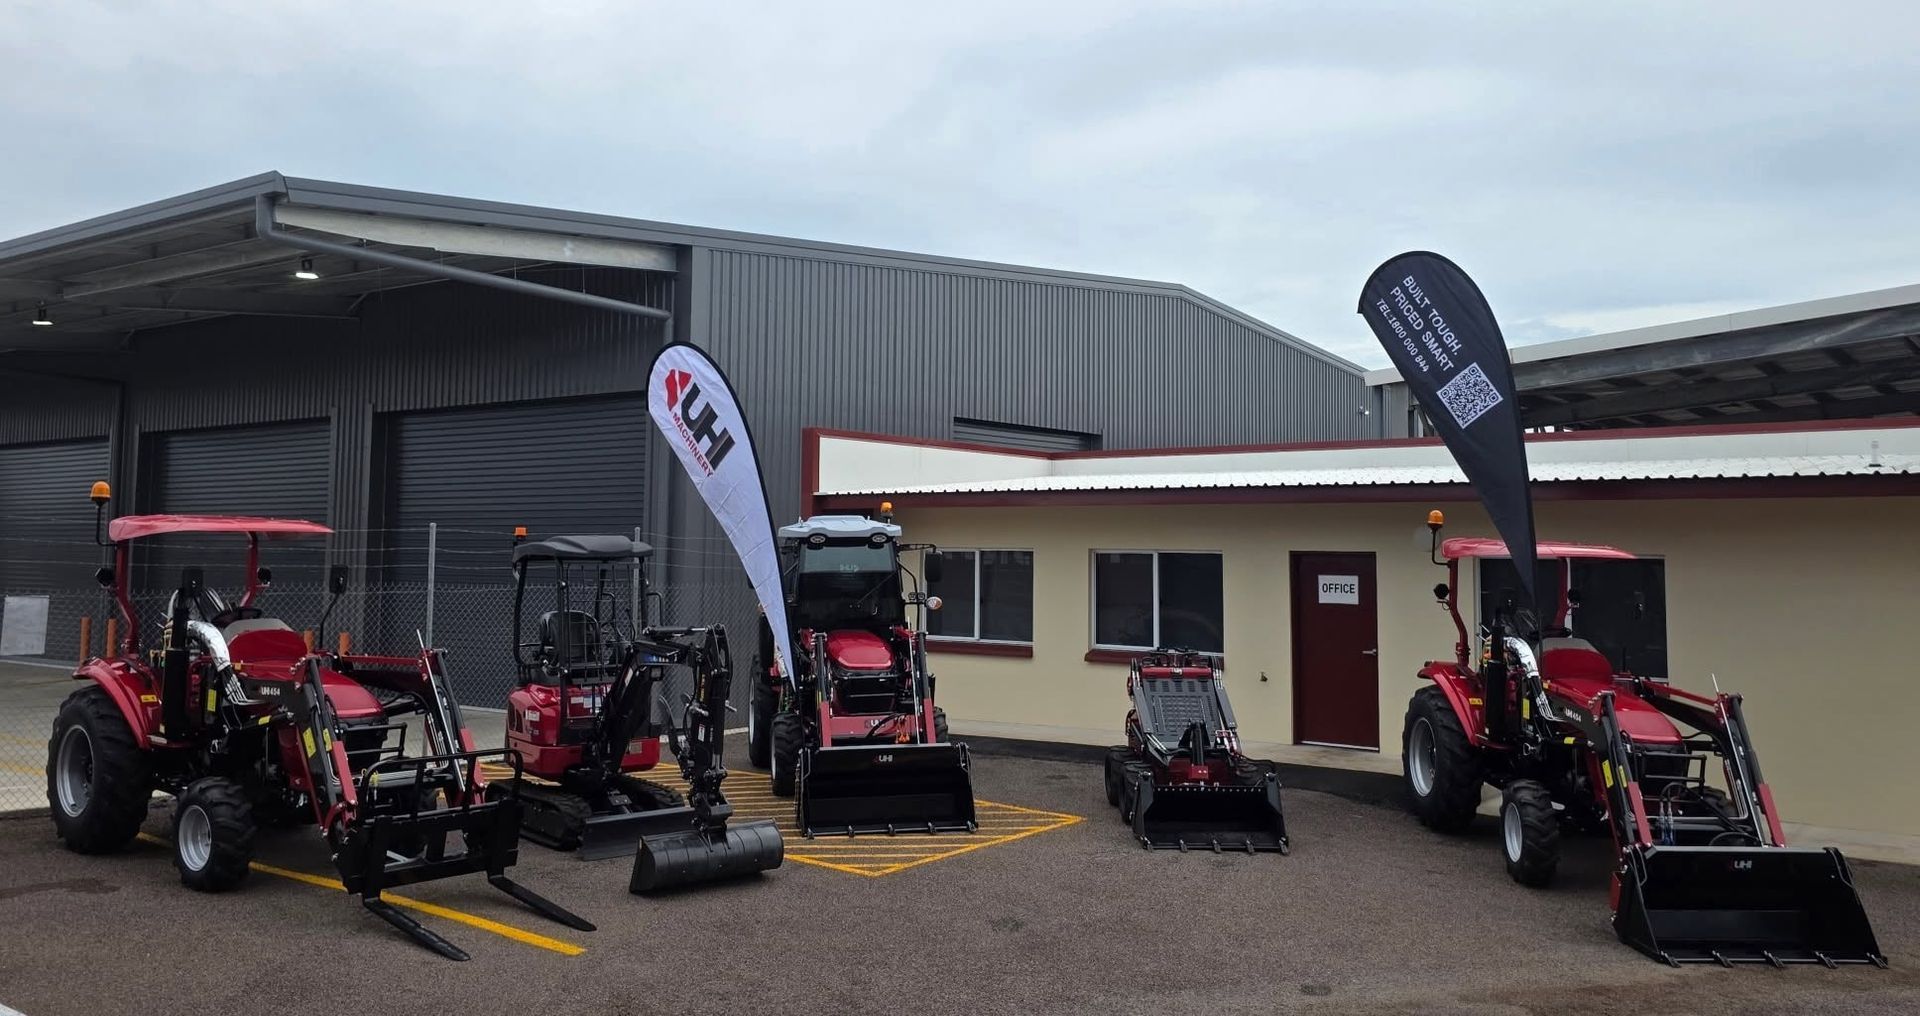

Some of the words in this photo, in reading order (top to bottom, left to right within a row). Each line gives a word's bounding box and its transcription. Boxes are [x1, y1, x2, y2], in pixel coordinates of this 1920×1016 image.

[1376, 298, 1407, 339] TEL:1800
[1403, 338, 1418, 356] 000
[1414, 355, 1430, 372] 844
[1390, 286, 1424, 330] PRICED
[1422, 331, 1454, 371] SMART
[1403, 275, 1430, 308] BUILT
[1428, 308, 1461, 356] TOUGH.
[672, 412, 714, 477] MACHINERY
[1322, 583, 1356, 594] OFFICE
